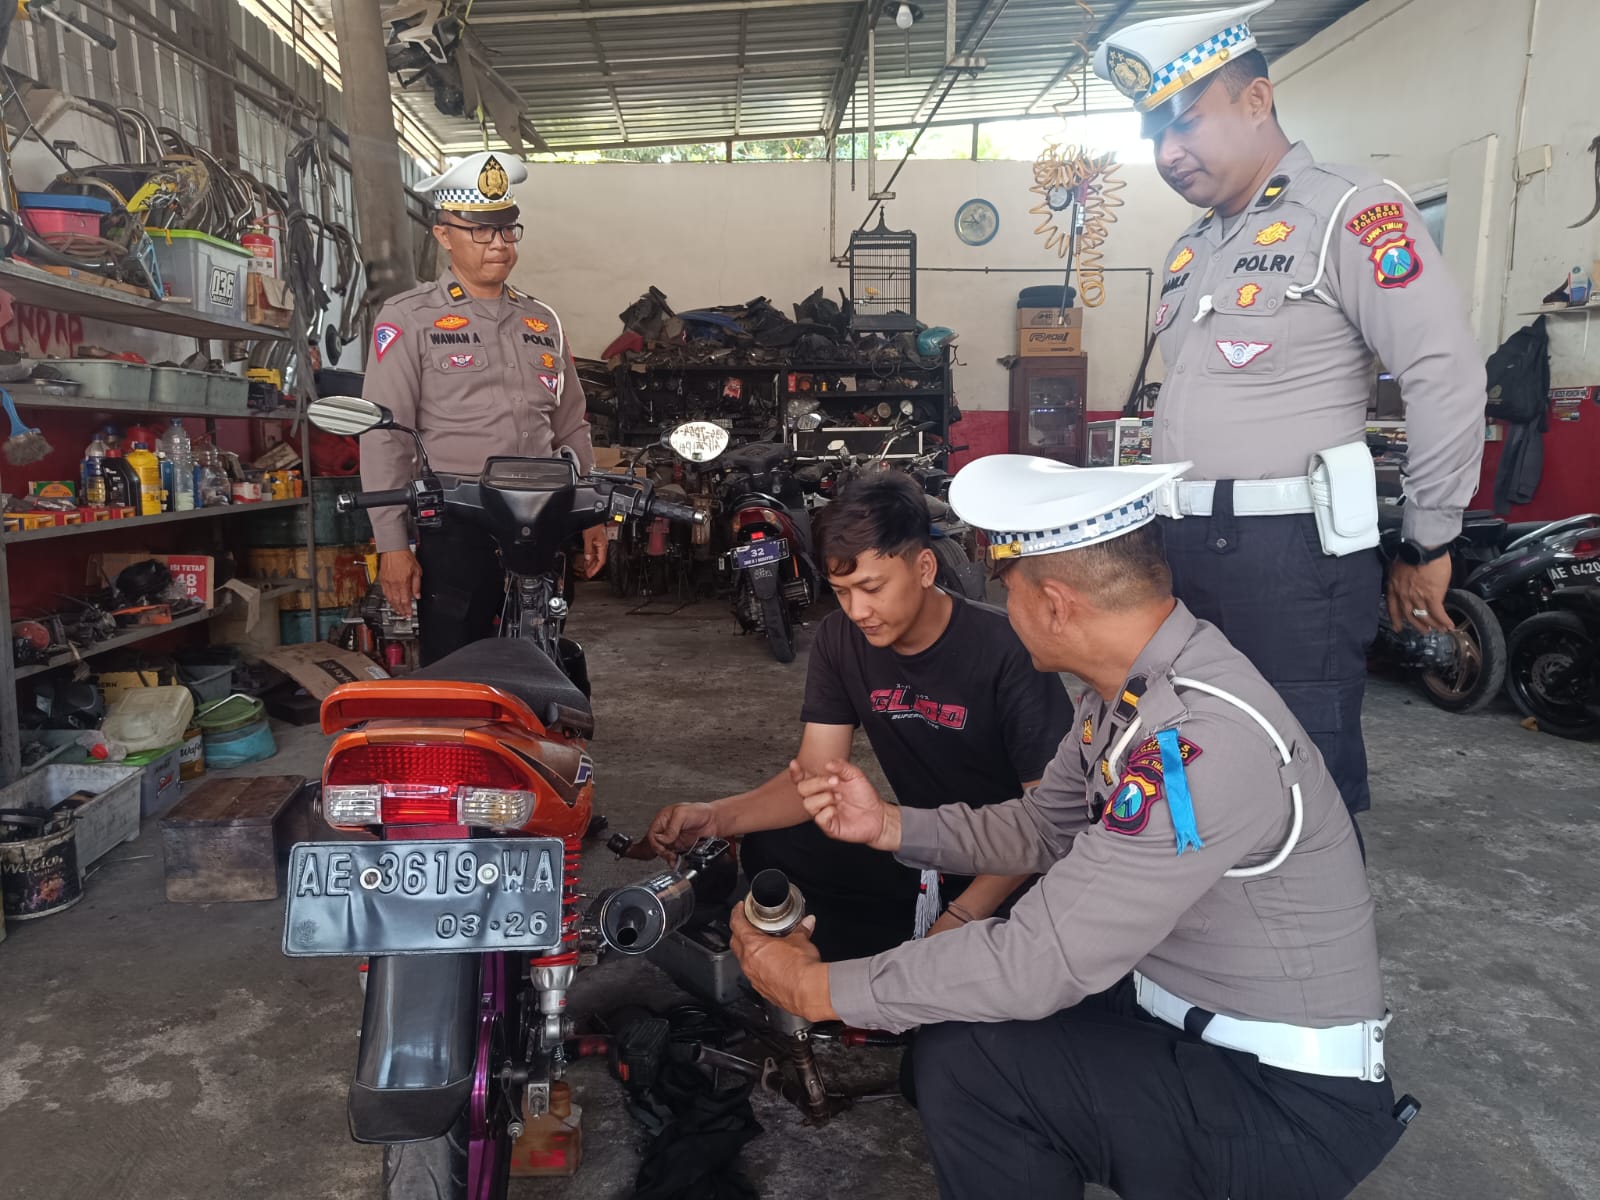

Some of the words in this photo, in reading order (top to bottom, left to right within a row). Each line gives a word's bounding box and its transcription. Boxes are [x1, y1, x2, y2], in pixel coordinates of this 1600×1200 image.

[1233, 254, 1295, 274] POLRI
[430, 333, 470, 345] WAWAN
[473, 333, 481, 344] A
[522, 333, 555, 348] POLRI
[750, 548, 765, 557] 32
[181, 564, 206, 572] TETAP
[1550, 566, 1568, 580] AE
[176, 573, 197, 587] 48
[296, 850, 352, 898] AE
[376, 850, 479, 895] 3619
[502, 849, 556, 895] WA
